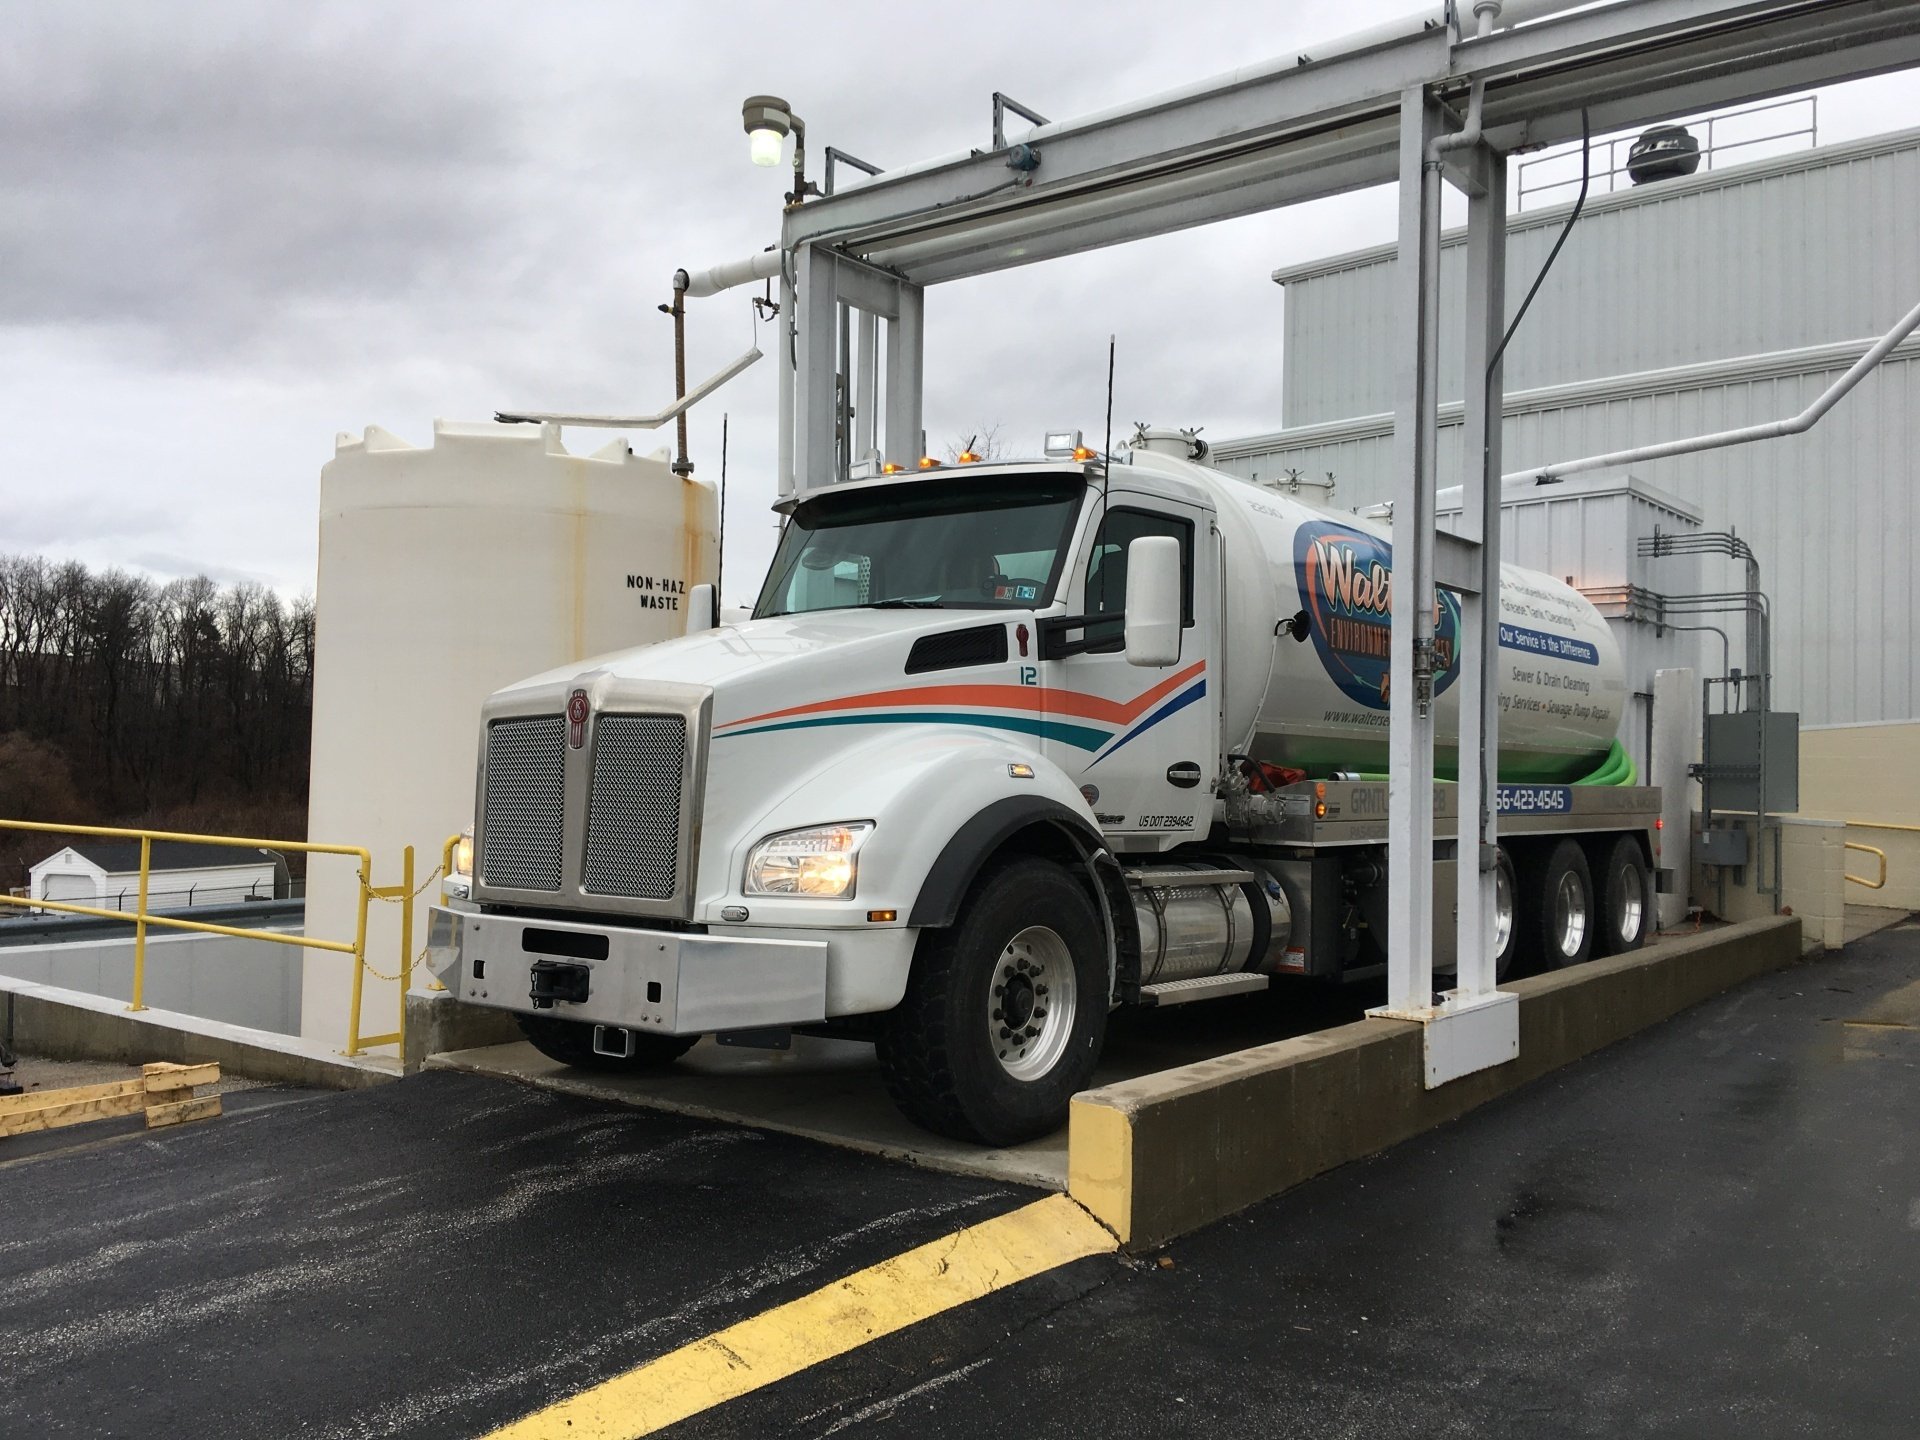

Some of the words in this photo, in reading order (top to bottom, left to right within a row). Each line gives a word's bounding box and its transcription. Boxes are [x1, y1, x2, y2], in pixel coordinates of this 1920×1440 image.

[640, 594, 679, 611] WASTE
[1500, 626, 1514, 641] Our
[1515, 630, 1540, 649] Service
[1539, 634, 1547, 650] is
[1547, 637, 1560, 653] the
[1560, 640, 1591, 659] Difference
[1020, 666, 1037, 685] 12
[1512, 666, 1535, 684] Sewer
[1536, 671, 1542, 685] &
[1544, 672, 1561, 688] Drain
[1563, 675, 1590, 696] Cleaning
[1512, 694, 1541, 712] Services
[1547, 700, 1573, 719] Sewage
[1573, 703, 1591, 720] Pump
[1591, 705, 1611, 722] Repair
[1323, 711, 1390, 727] www.walterse
[1138, 815, 1150, 827] US
[1149, 815, 1165, 827] DOT
[1163, 815, 1194, 827] 2394642
